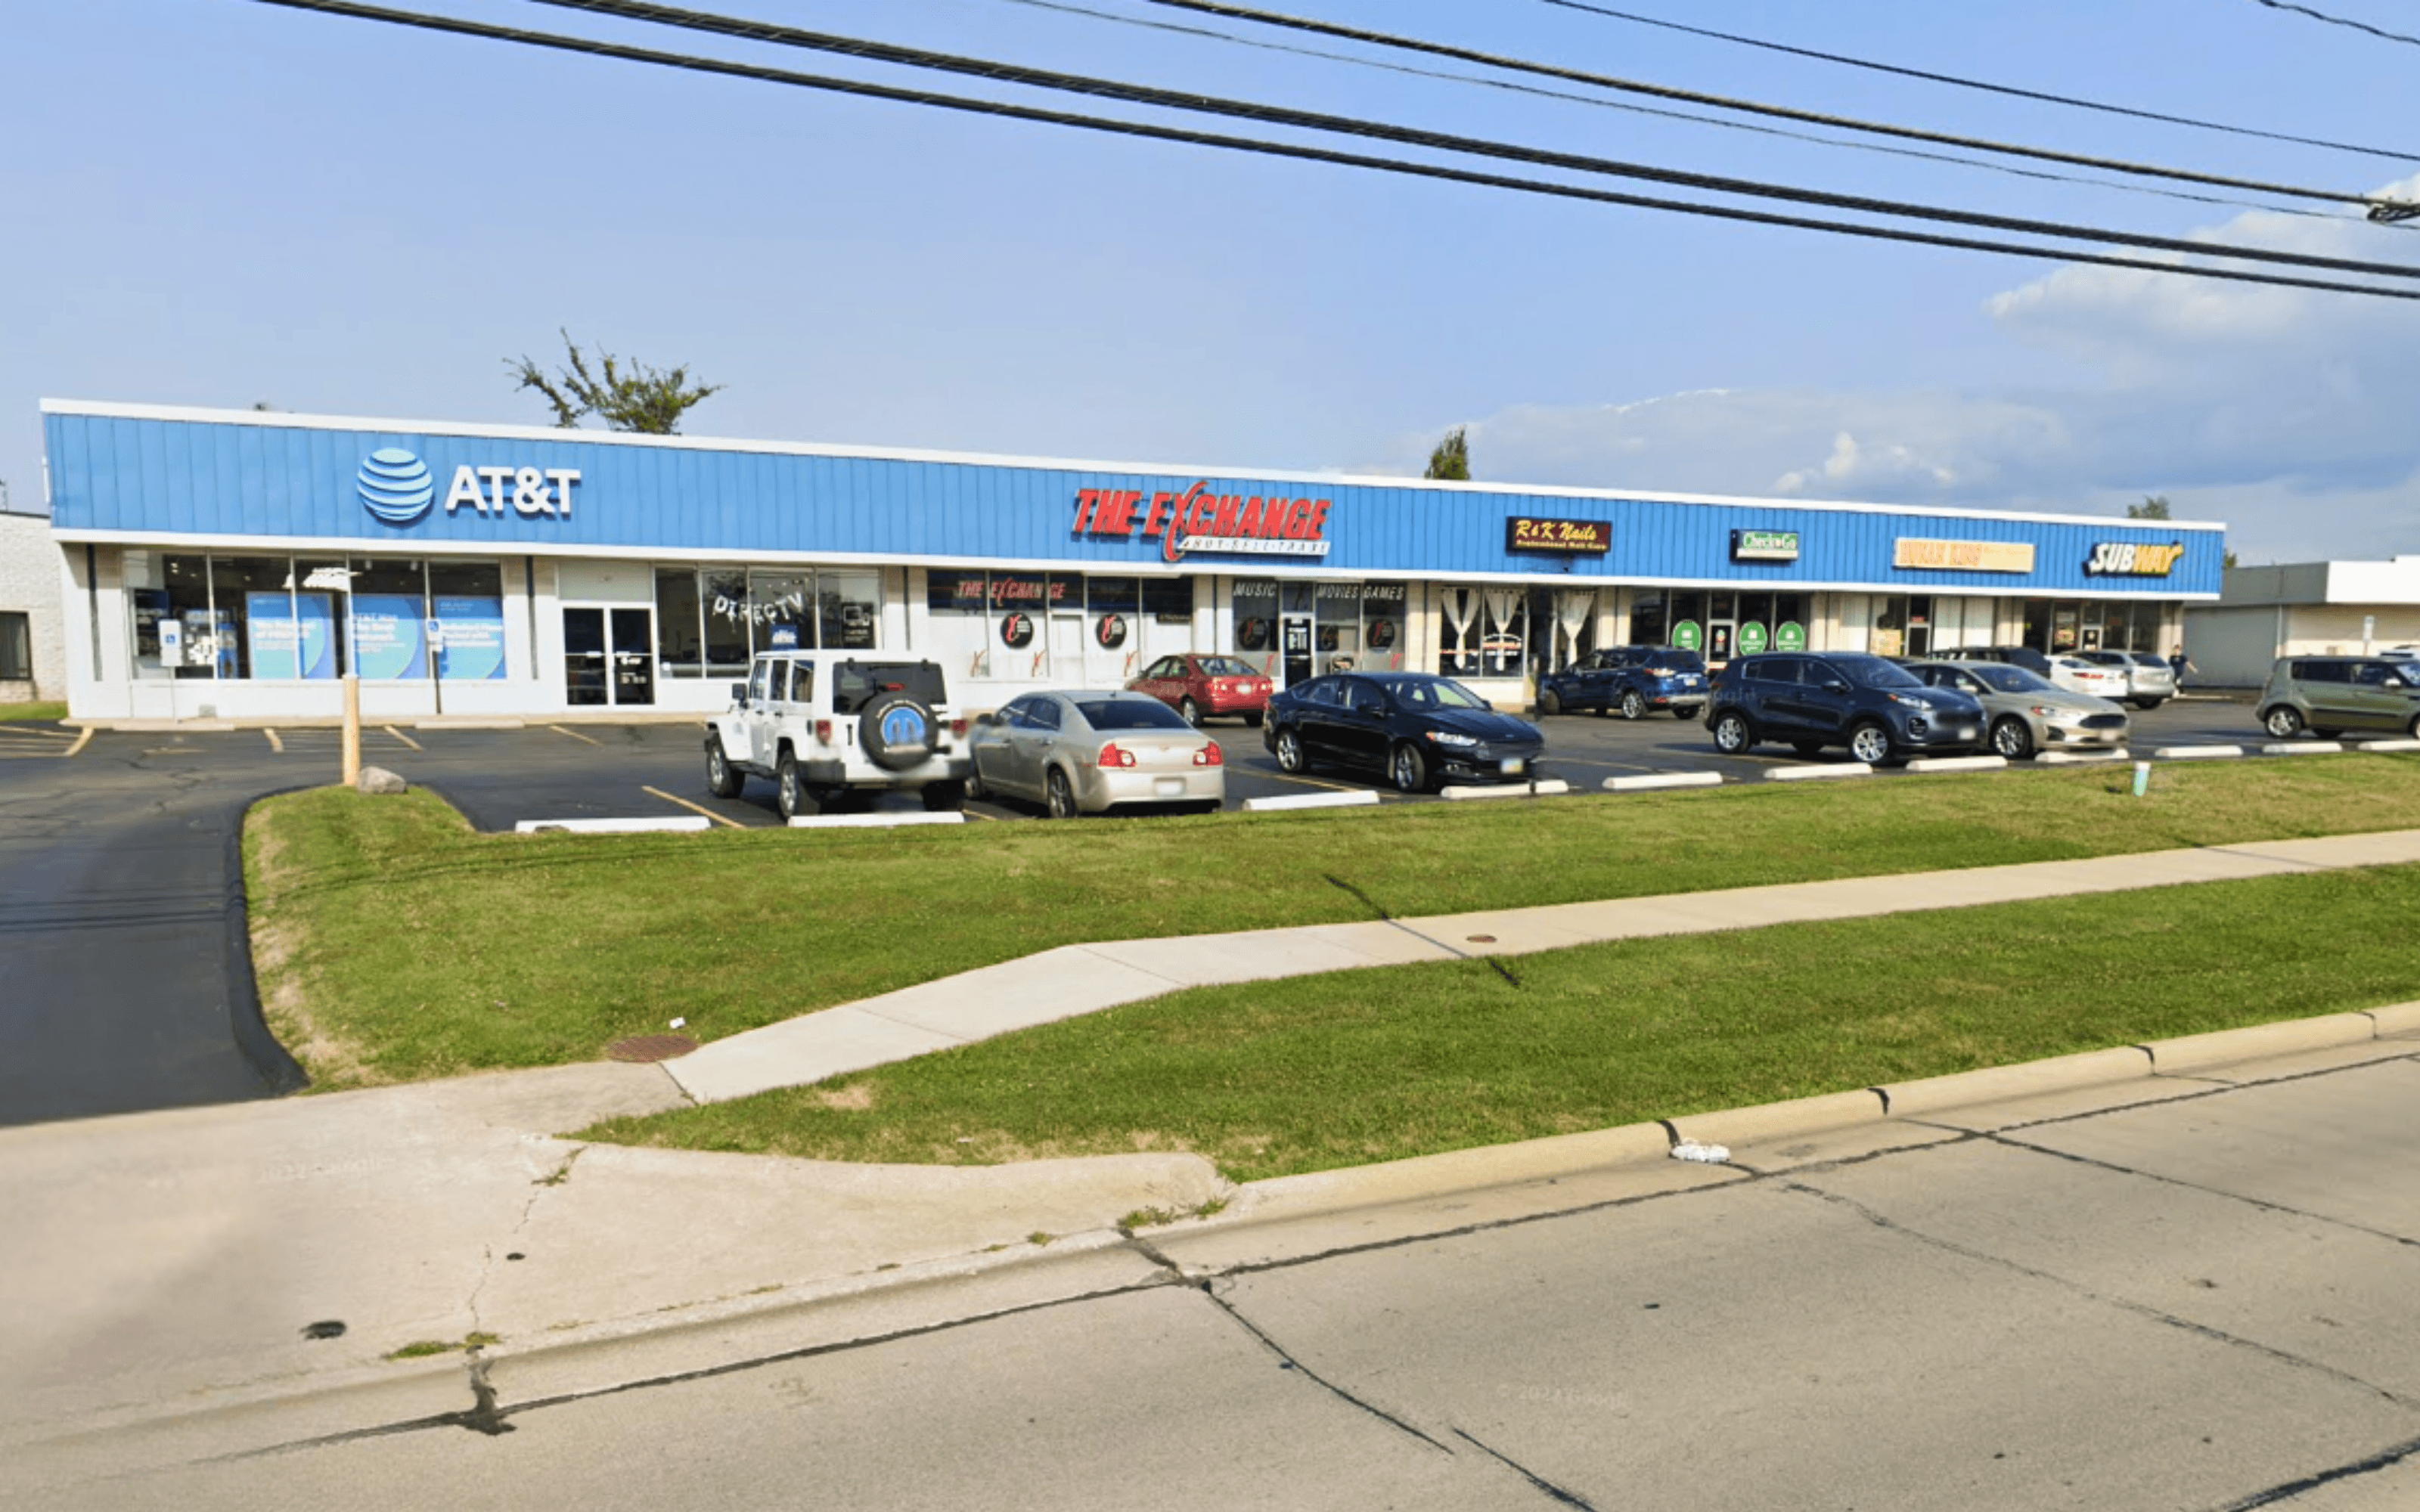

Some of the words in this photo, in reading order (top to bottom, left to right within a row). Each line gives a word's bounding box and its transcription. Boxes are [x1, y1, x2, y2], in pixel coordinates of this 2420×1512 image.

[445, 464, 582, 515] AT&T
[1074, 489, 1142, 535] THE
[1144, 480, 1332, 561] EXCHANGE
[1516, 519, 1531, 538] R
[1541, 522, 1556, 540] K
[1559, 521, 1597, 541] Nails
[2088, 543, 2184, 574] SUBWAY
[957, 580, 985, 598] THE
[991, 578, 1066, 606] EXCHANGE
[1233, 581, 1278, 598] MUSIC
[1316, 583, 1360, 600] MOVIES
[1364, 584, 1405, 601] GAMES
[712, 591, 805, 626] DIRECTV
